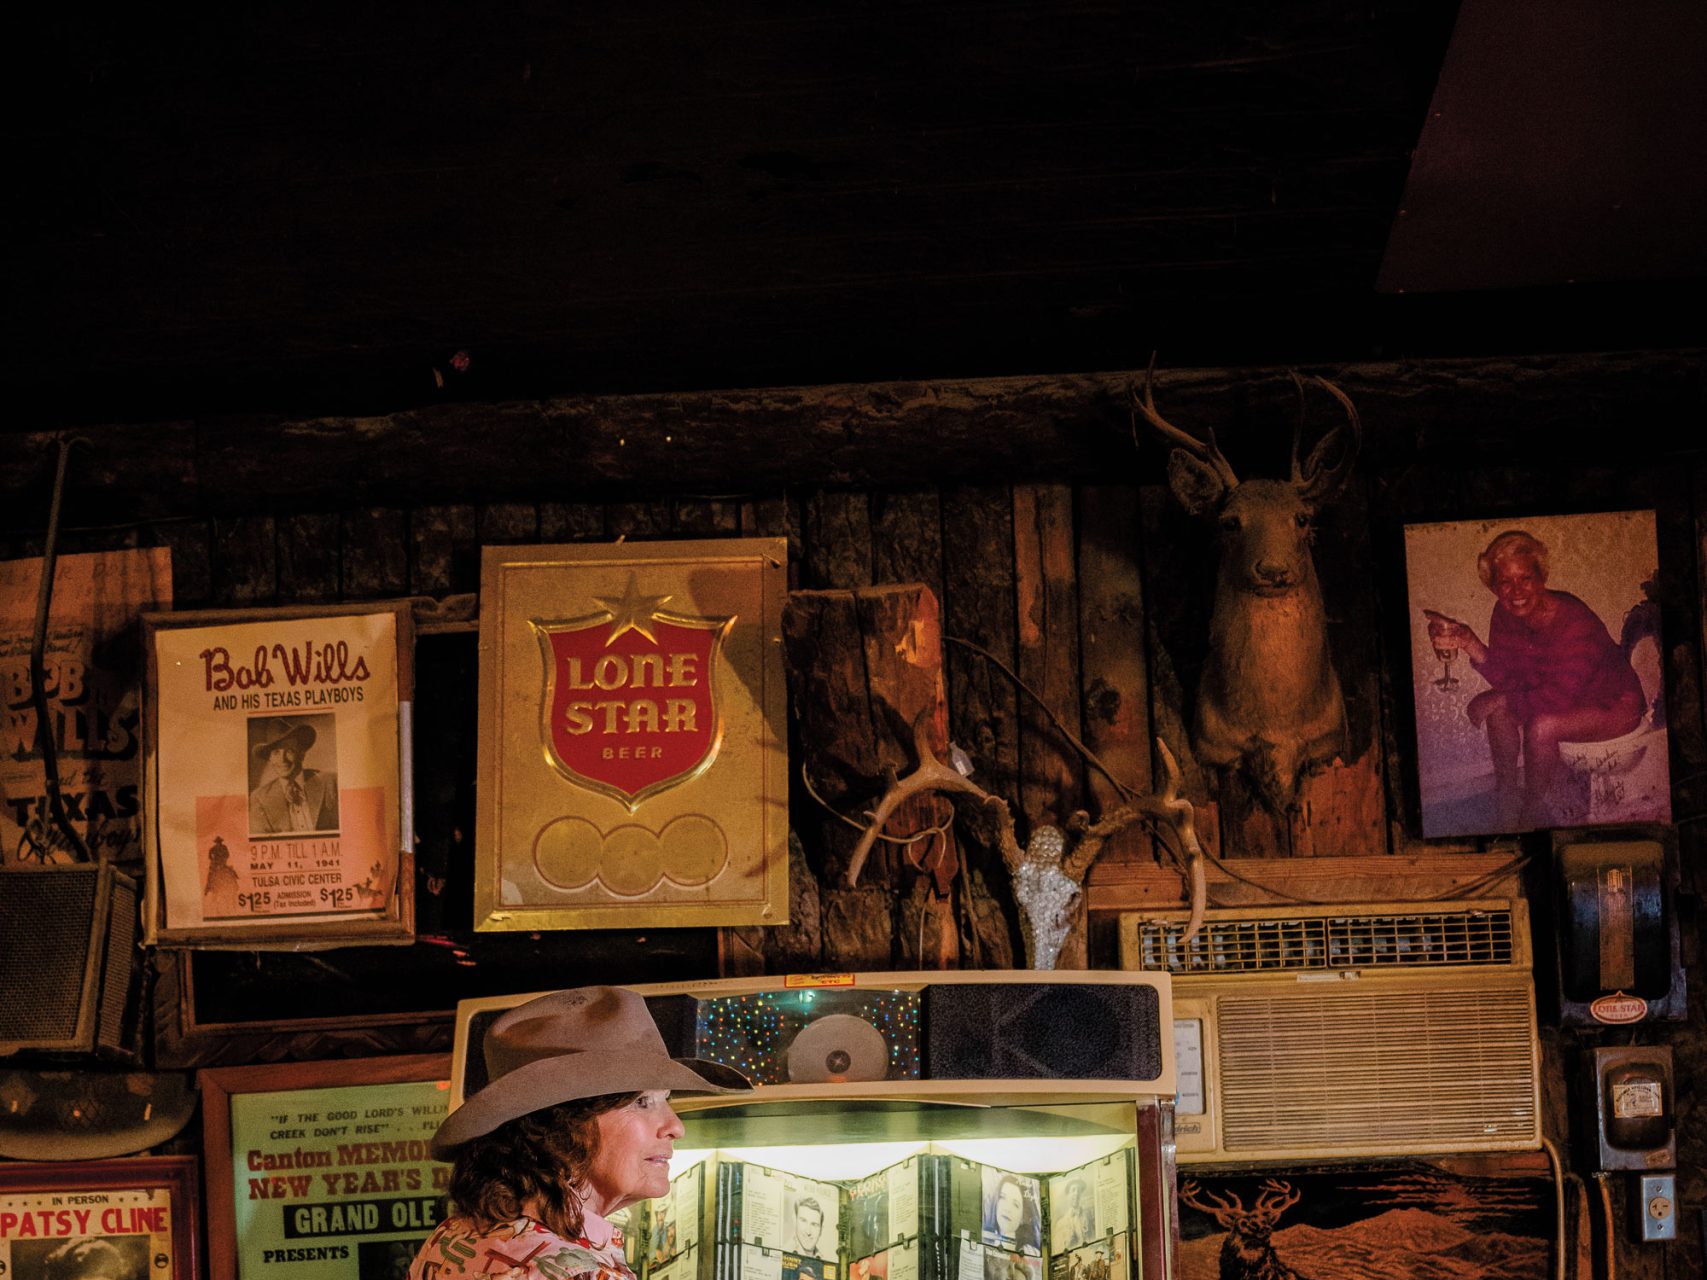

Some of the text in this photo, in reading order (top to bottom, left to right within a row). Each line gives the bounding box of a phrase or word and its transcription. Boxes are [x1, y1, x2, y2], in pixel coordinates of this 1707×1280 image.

[200, 641, 370, 691] Bob Wills
[566, 653, 699, 691] LONE
[213, 686, 364, 711] AND HIS TEXAS PLAYBOYS
[565, 698, 699, 736] STAR
[602, 746, 662, 760] BEER
[250, 845, 258, 860] 9
[287, 841, 307, 858] TILL
[312, 843, 317, 858] 1
[250, 862, 274, 870] MAY
[315, 859, 340, 867] 1941
[252, 872, 342, 887] TULSA CIVIC CENTER
[277, 890, 312, 899] ADMISSION
[297, 1113, 319, 1123] THE
[327, 1112, 357, 1121] GOOD
[364, 1107, 404, 1118] LORD'S
[270, 1130, 306, 1140] CREEK
[314, 1126, 348, 1137] DON'T
[247, 1147, 332, 1171] Canton
[248, 1175, 313, 1199] NEW
[321, 1168, 422, 1195] YEAR'S
[52, 1194, 110, 1206] IN PERSON
[0, 1207, 168, 1238] PATSY CLINE
[294, 1199, 436, 1234] GRAND OLE
[263, 1246, 350, 1263] PRESENTS
